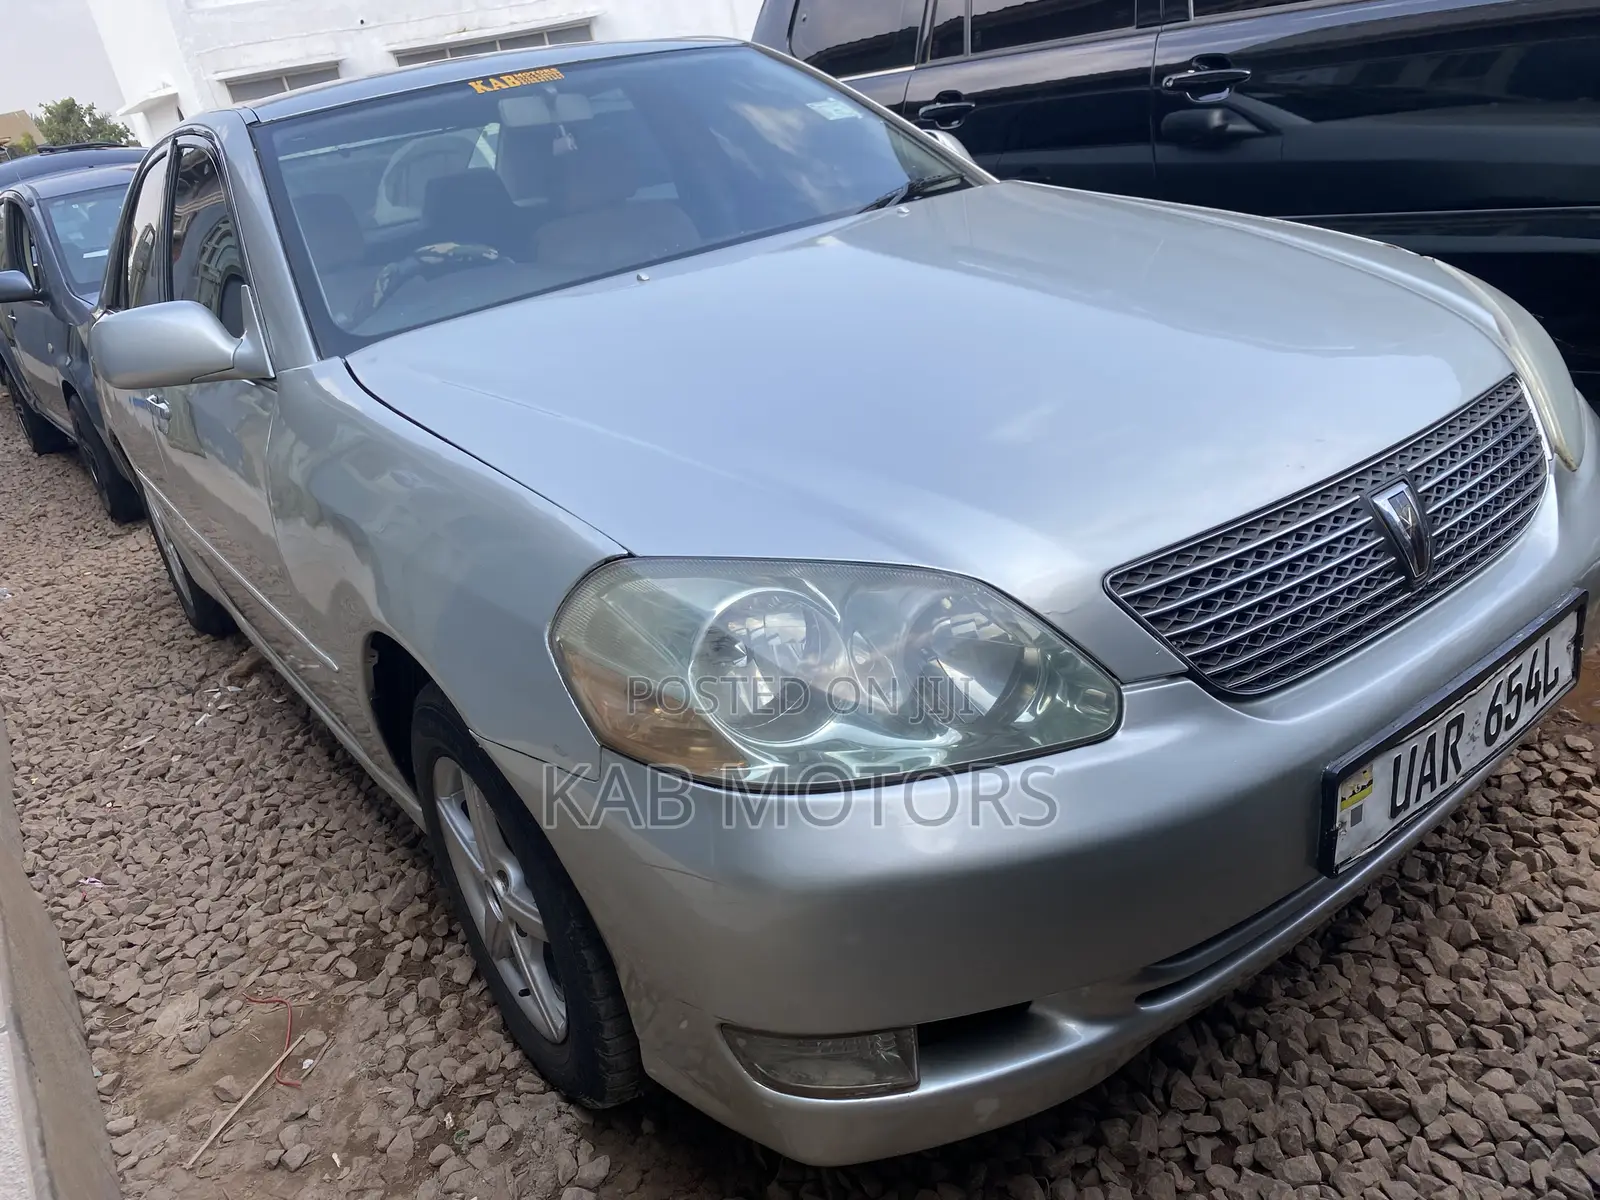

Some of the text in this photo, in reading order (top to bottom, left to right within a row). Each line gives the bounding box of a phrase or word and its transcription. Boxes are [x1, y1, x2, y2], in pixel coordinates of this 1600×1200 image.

[468, 74, 521, 94] KAB
[1389, 637, 1560, 820] UAR 654L
